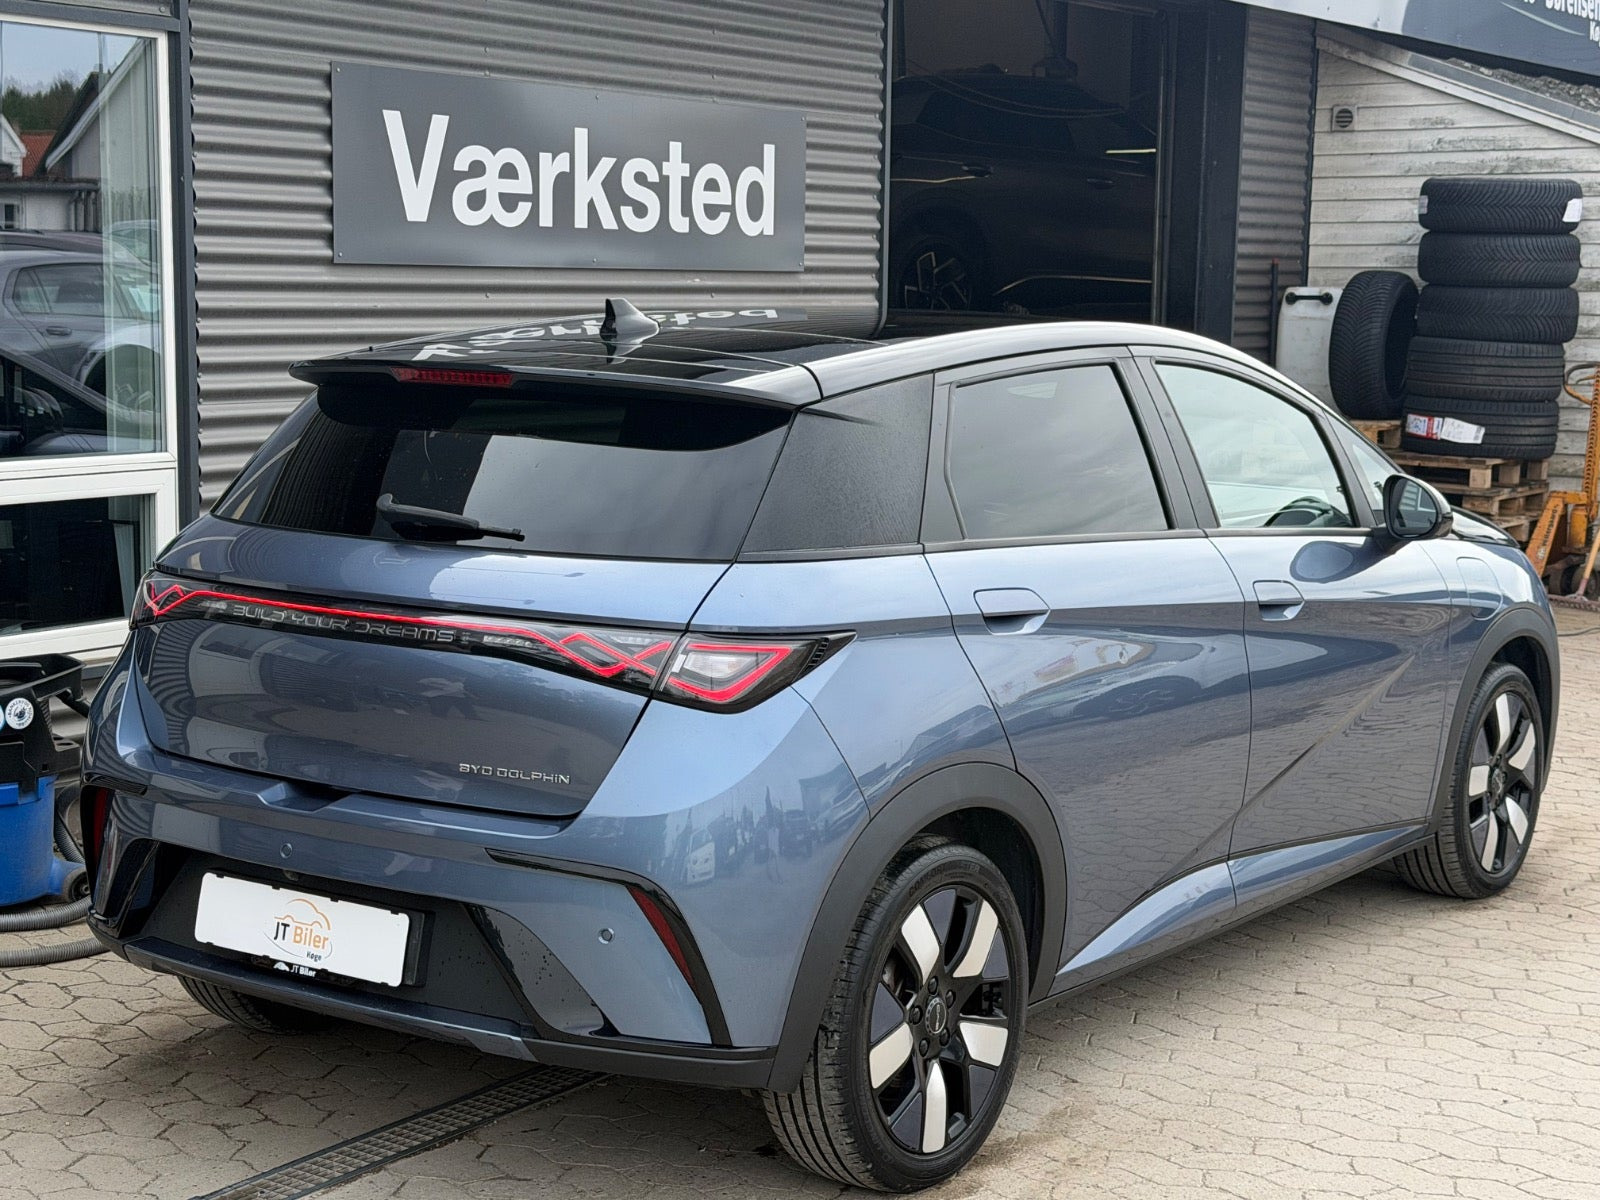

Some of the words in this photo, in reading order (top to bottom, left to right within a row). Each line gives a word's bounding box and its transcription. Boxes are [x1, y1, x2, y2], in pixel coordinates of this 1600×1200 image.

[382, 109, 776, 237] Værksted
[233, 604, 287, 623] BUILD
[291, 611, 350, 631] YOUR
[354, 622, 457, 643] DREAMS
[459, 763, 493, 776] BYD
[273, 921, 290, 941] JT
[293, 925, 329, 950] Biler
[290, 965, 299, 974] JT
[299, 966, 317, 977] Biler
